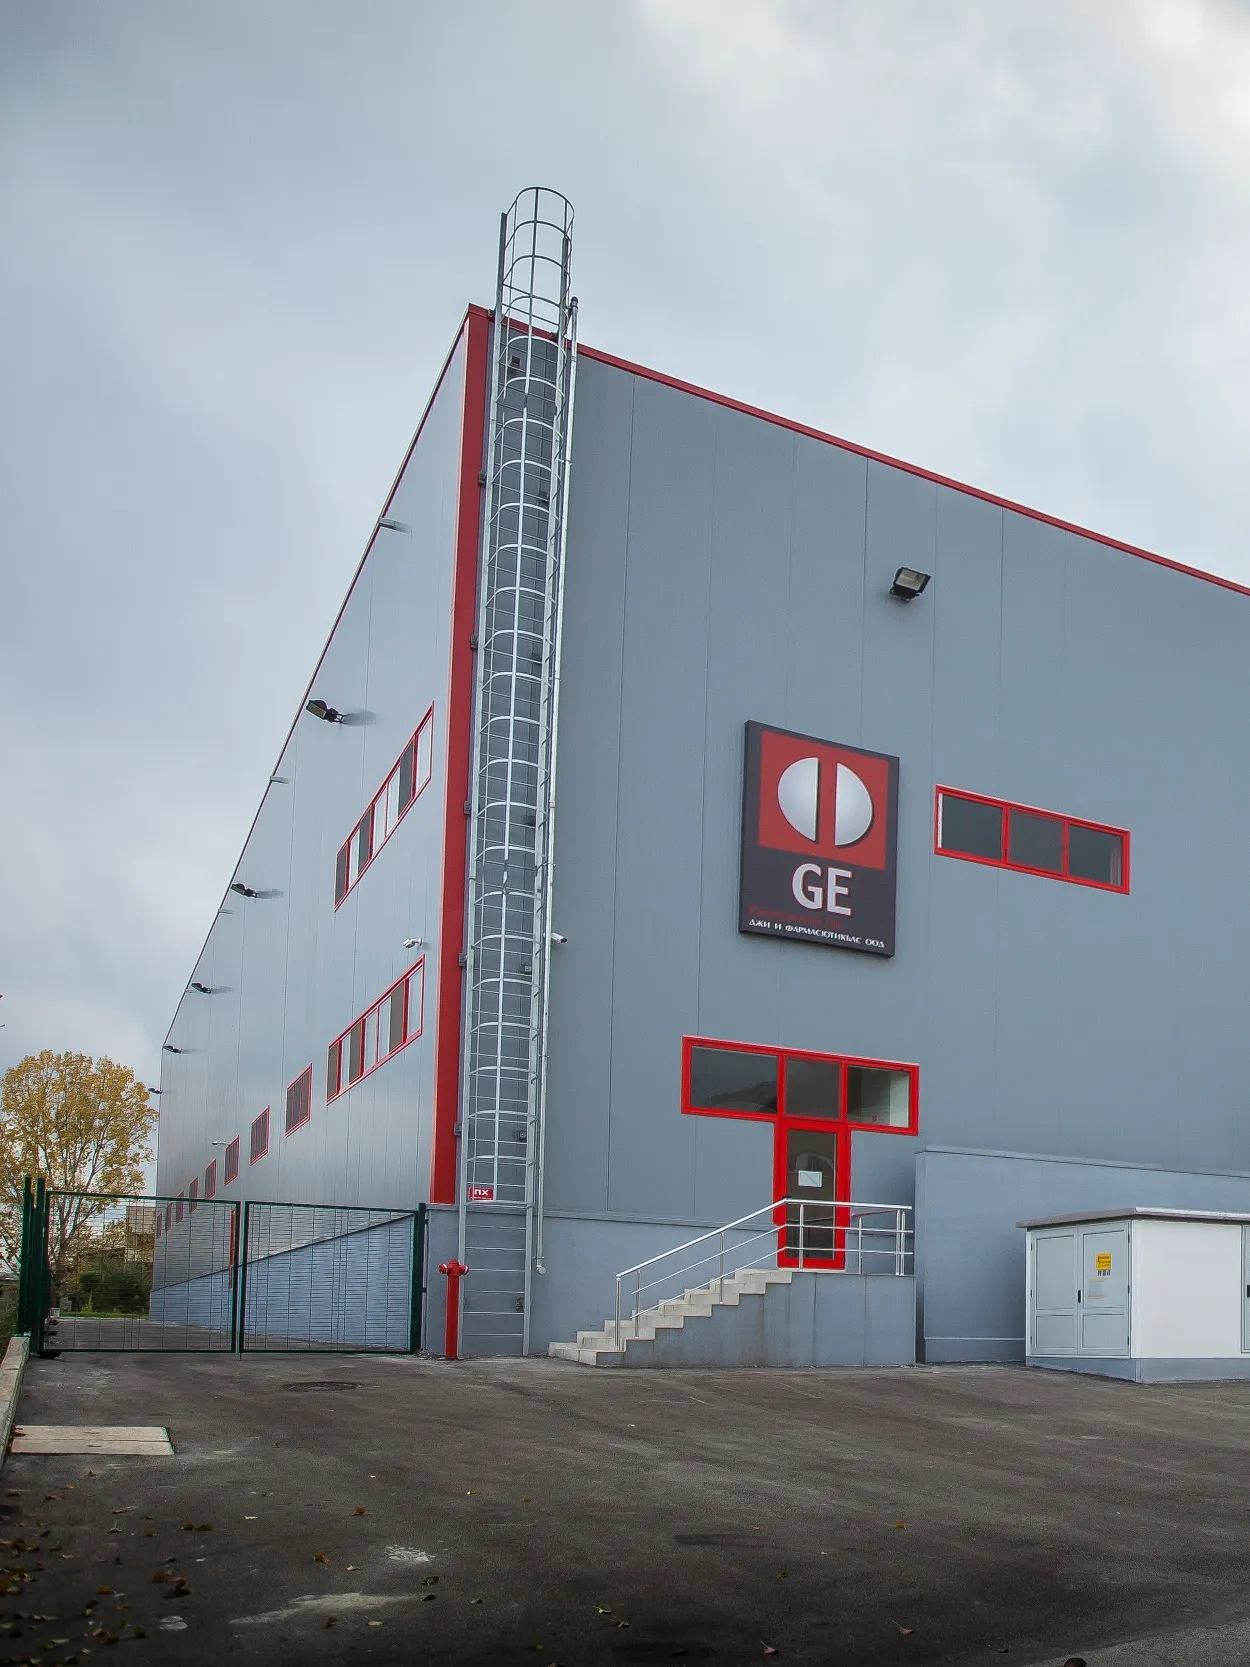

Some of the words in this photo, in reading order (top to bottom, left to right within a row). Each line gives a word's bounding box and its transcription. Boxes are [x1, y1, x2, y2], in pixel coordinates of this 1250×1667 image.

[791, 863, 852, 916] GE
[749, 918, 771, 929] ДЖИ
[774, 922, 782, 931] И
[785, 924, 862, 945] ФАРМАСЮТИКЪЛС
[865, 938, 885, 949] ООД
